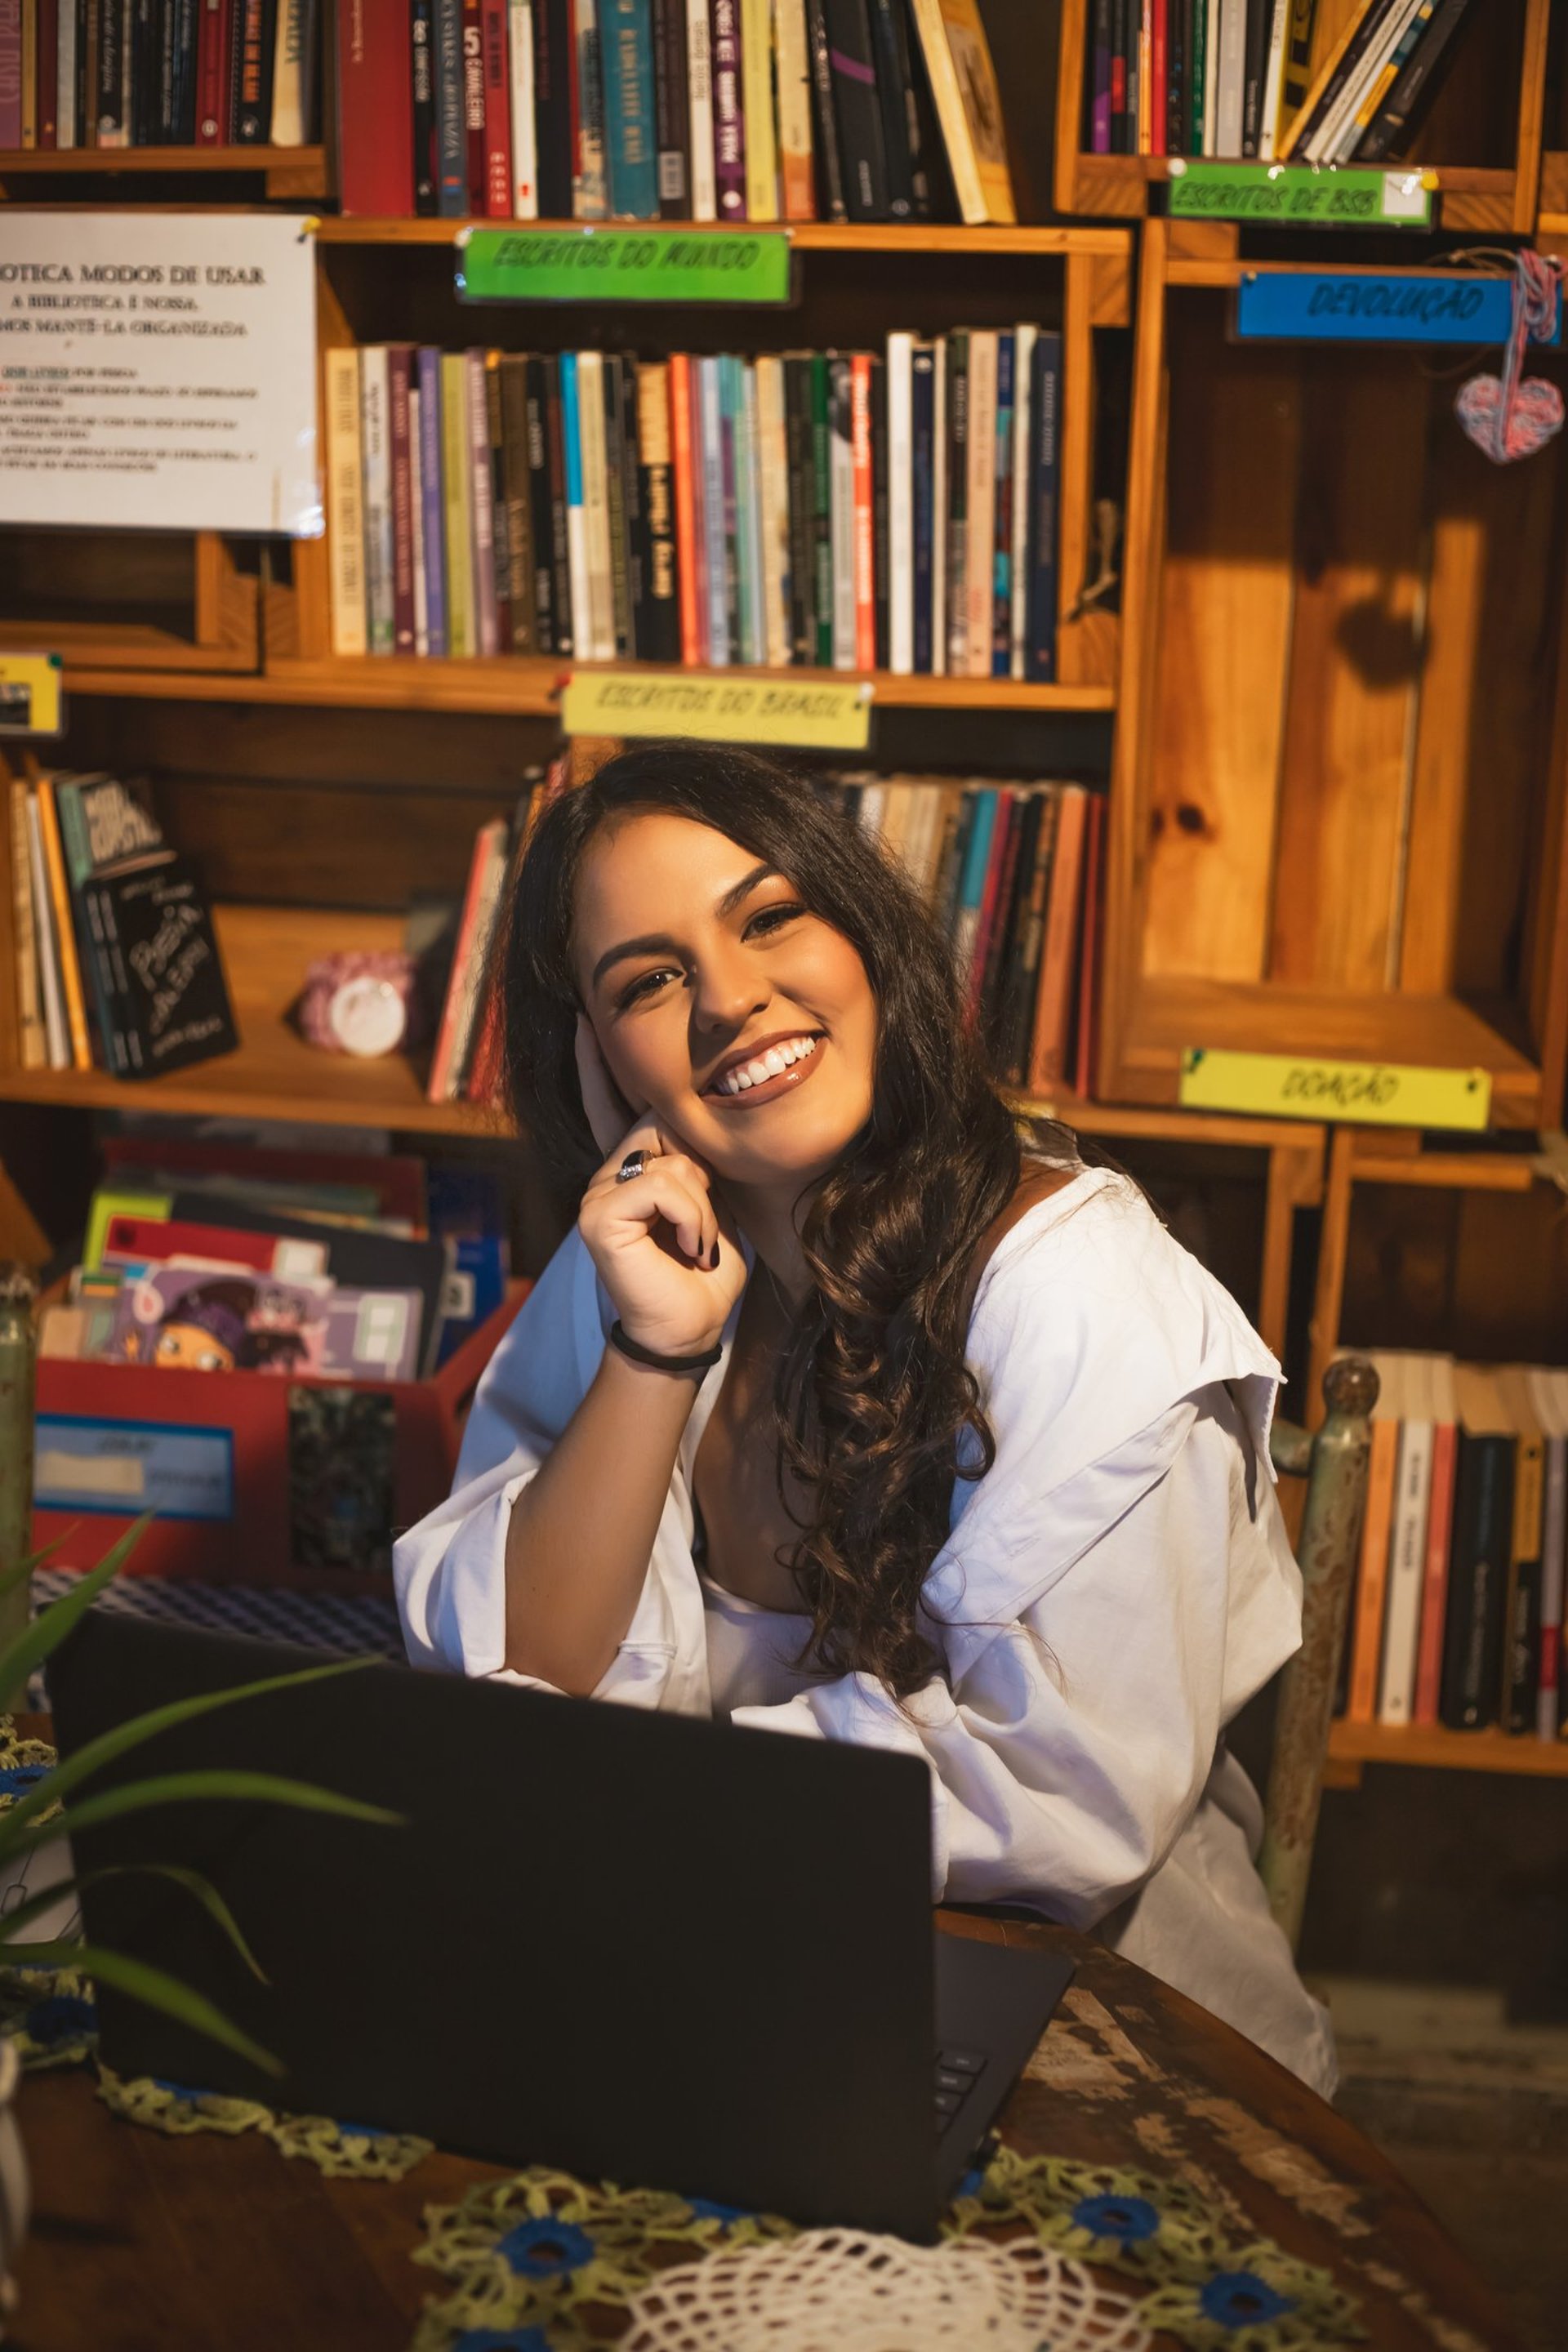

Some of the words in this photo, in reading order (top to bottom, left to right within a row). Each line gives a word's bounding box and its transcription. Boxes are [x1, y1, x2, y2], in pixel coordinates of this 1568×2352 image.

[1174, 182, 1287, 212] ESCRITOS
[1290, 188, 1328, 213] DE
[494, 238, 614, 267] ESCRITOS
[617, 239, 658, 270] DO
[81, 265, 163, 285] MODOS
[169, 265, 198, 285] DE
[205, 265, 265, 285] USAR
[11, 295, 23, 310] A
[28, 294, 123, 310] BIBLIOTECA
[1307, 281, 1485, 324] DEVOLUÇÃO
